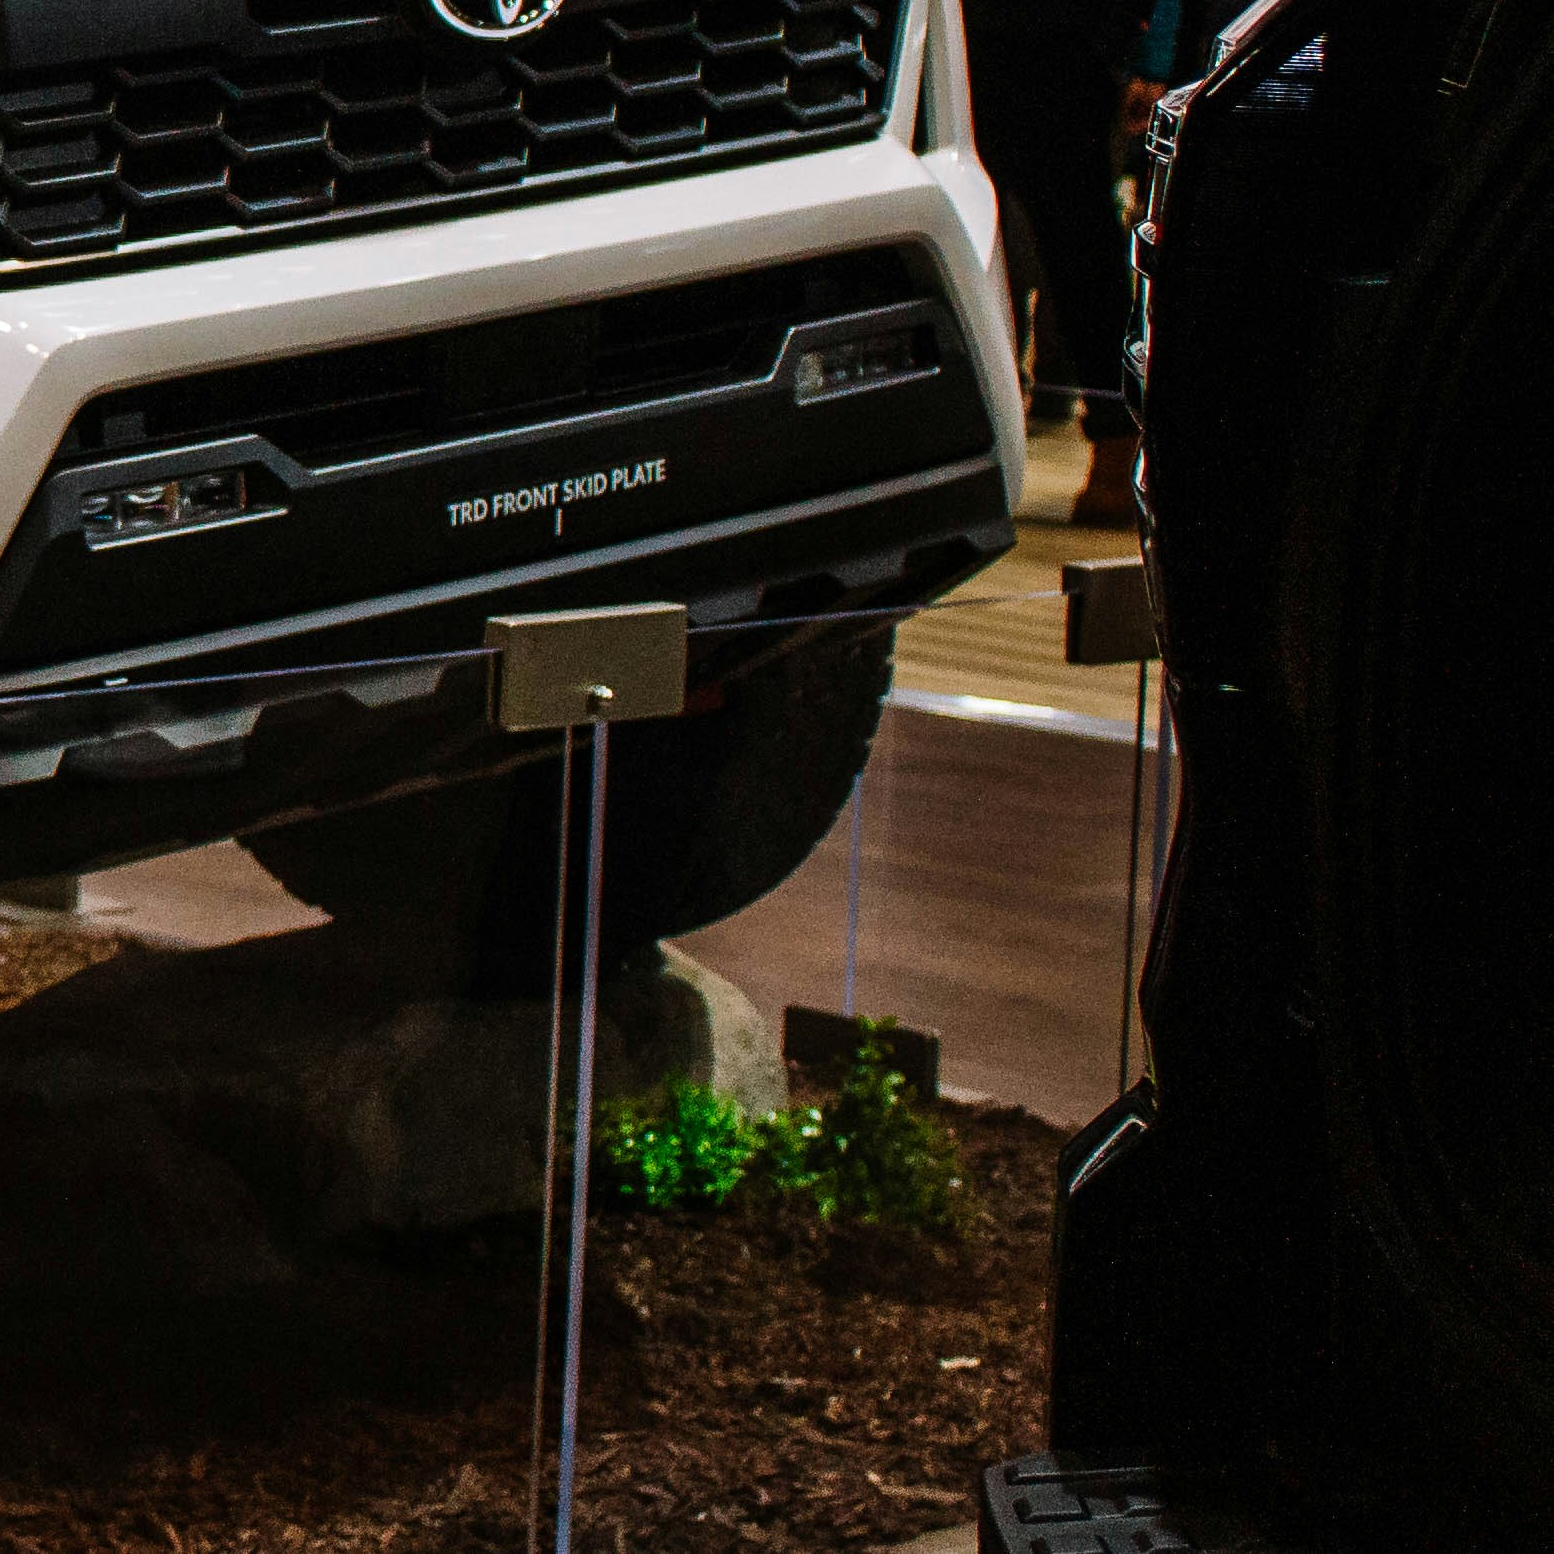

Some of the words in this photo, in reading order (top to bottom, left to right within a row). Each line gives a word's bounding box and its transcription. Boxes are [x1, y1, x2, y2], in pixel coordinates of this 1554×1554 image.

[446, 498, 489, 526] TRD
[492, 482, 559, 518] FRONT
[562, 472, 608, 502] SKID
[611, 458, 667, 491] PLATE
